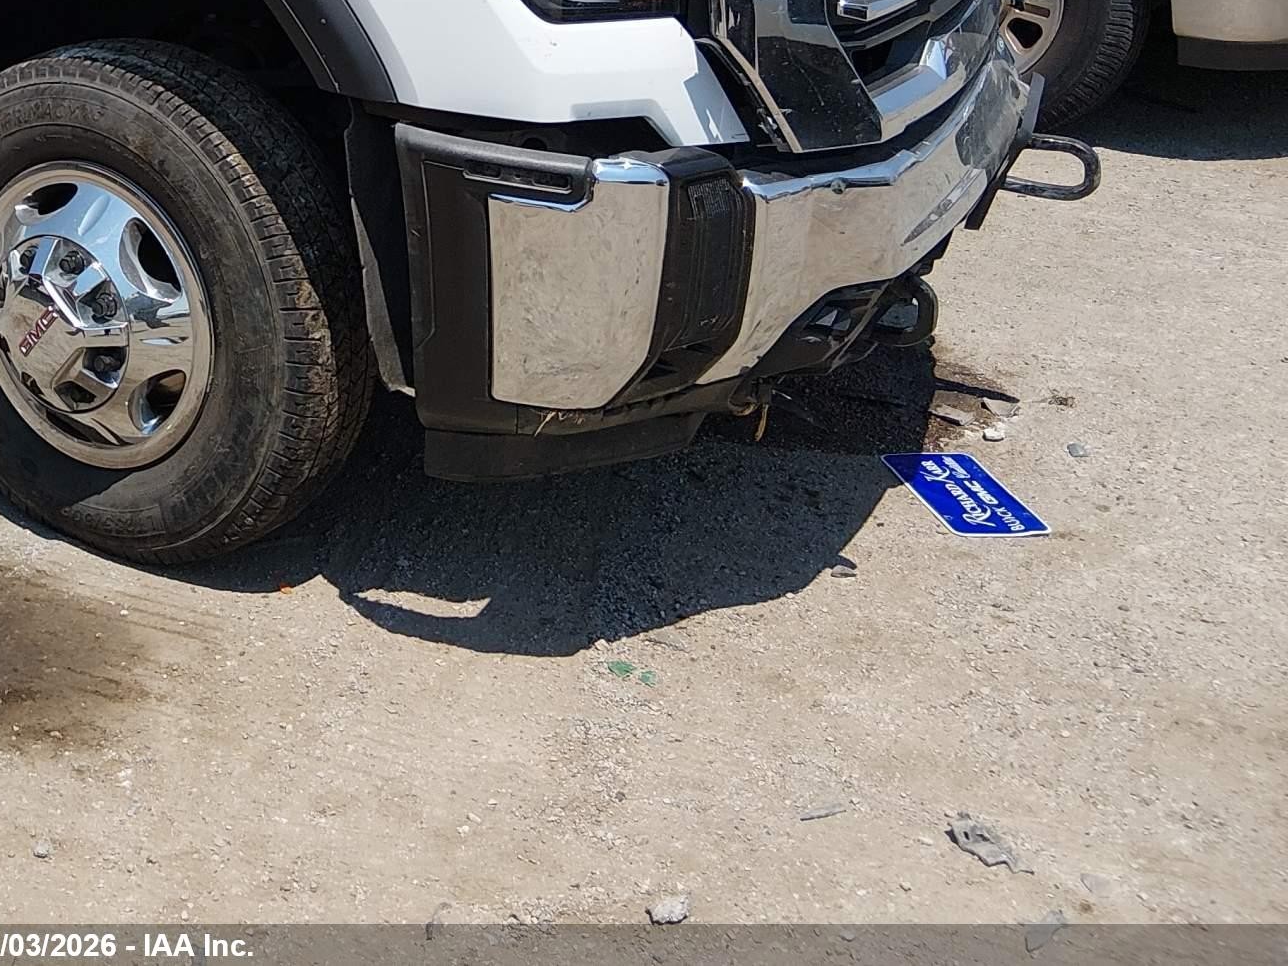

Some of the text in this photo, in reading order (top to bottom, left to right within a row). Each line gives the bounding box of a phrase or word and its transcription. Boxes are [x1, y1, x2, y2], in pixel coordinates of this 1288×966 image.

[19, 306, 58, 357] GMC
[919, 460, 997, 527] RICHARD KARR
[963, 480, 999, 505] GMC
[992, 506, 1026, 531] BUICK
